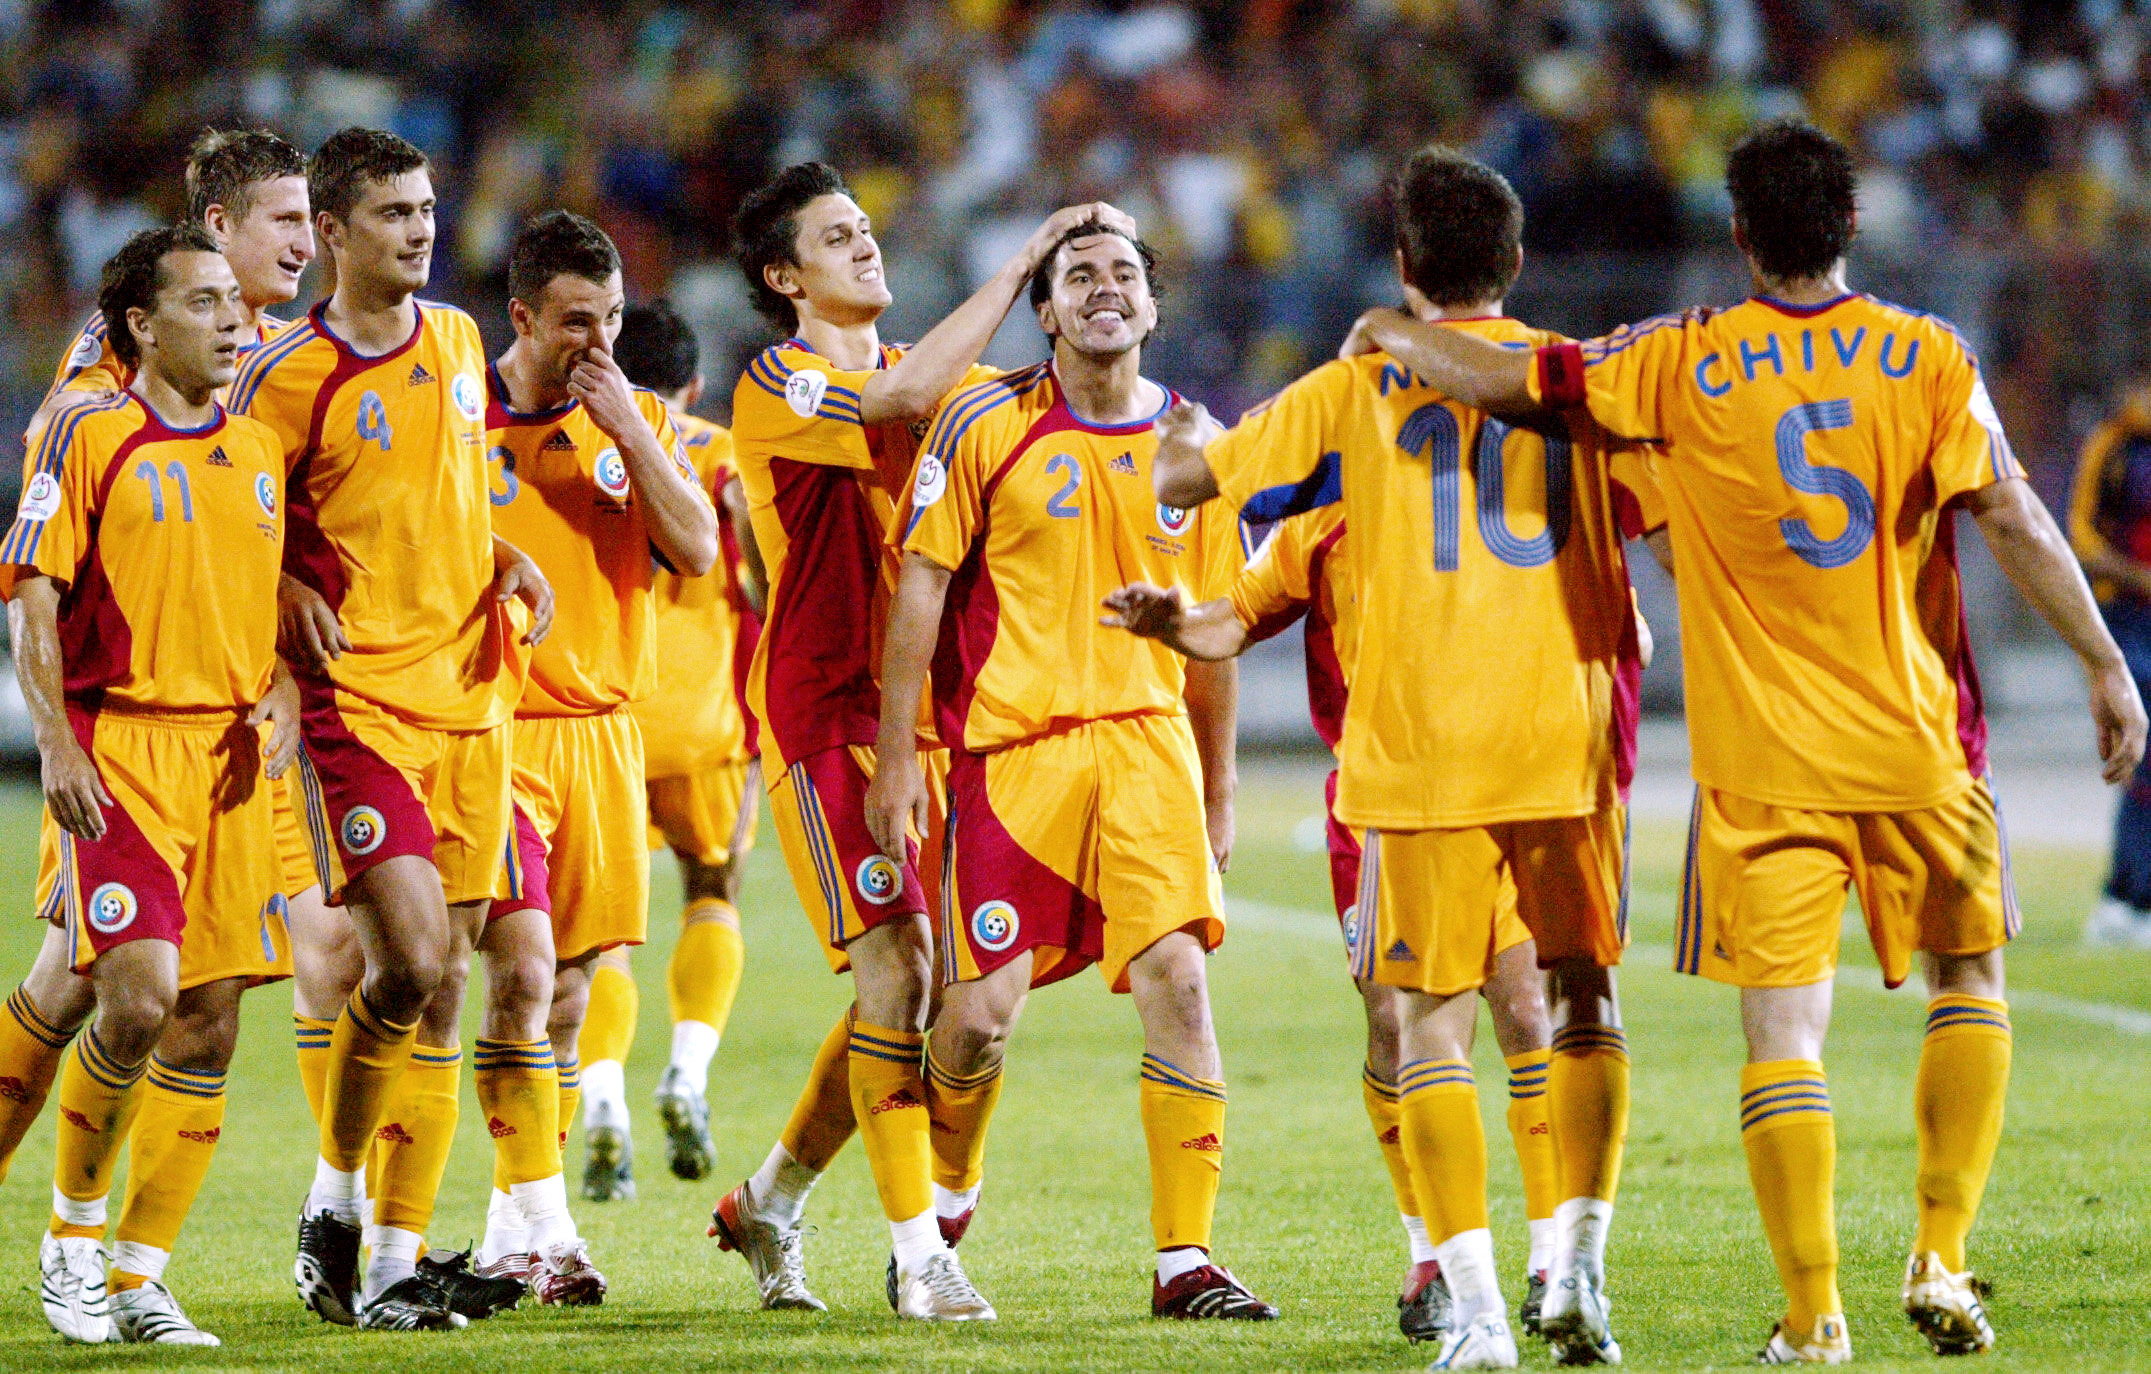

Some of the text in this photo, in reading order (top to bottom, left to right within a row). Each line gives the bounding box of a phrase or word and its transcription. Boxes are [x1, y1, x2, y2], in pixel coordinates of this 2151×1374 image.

[1696, 326, 1919, 397] CHIVU
[356, 389, 393, 451] 4
[135, 460, 193, 522] 11
[487, 446, 519, 507] 3
[1045, 453, 1081, 518] 2
[1395, 402, 1572, 572] 10
[1774, 398, 1876, 569] 5
[1181, 1138, 1223, 1152] adida
[1485, 1322, 1505, 1337] 10
